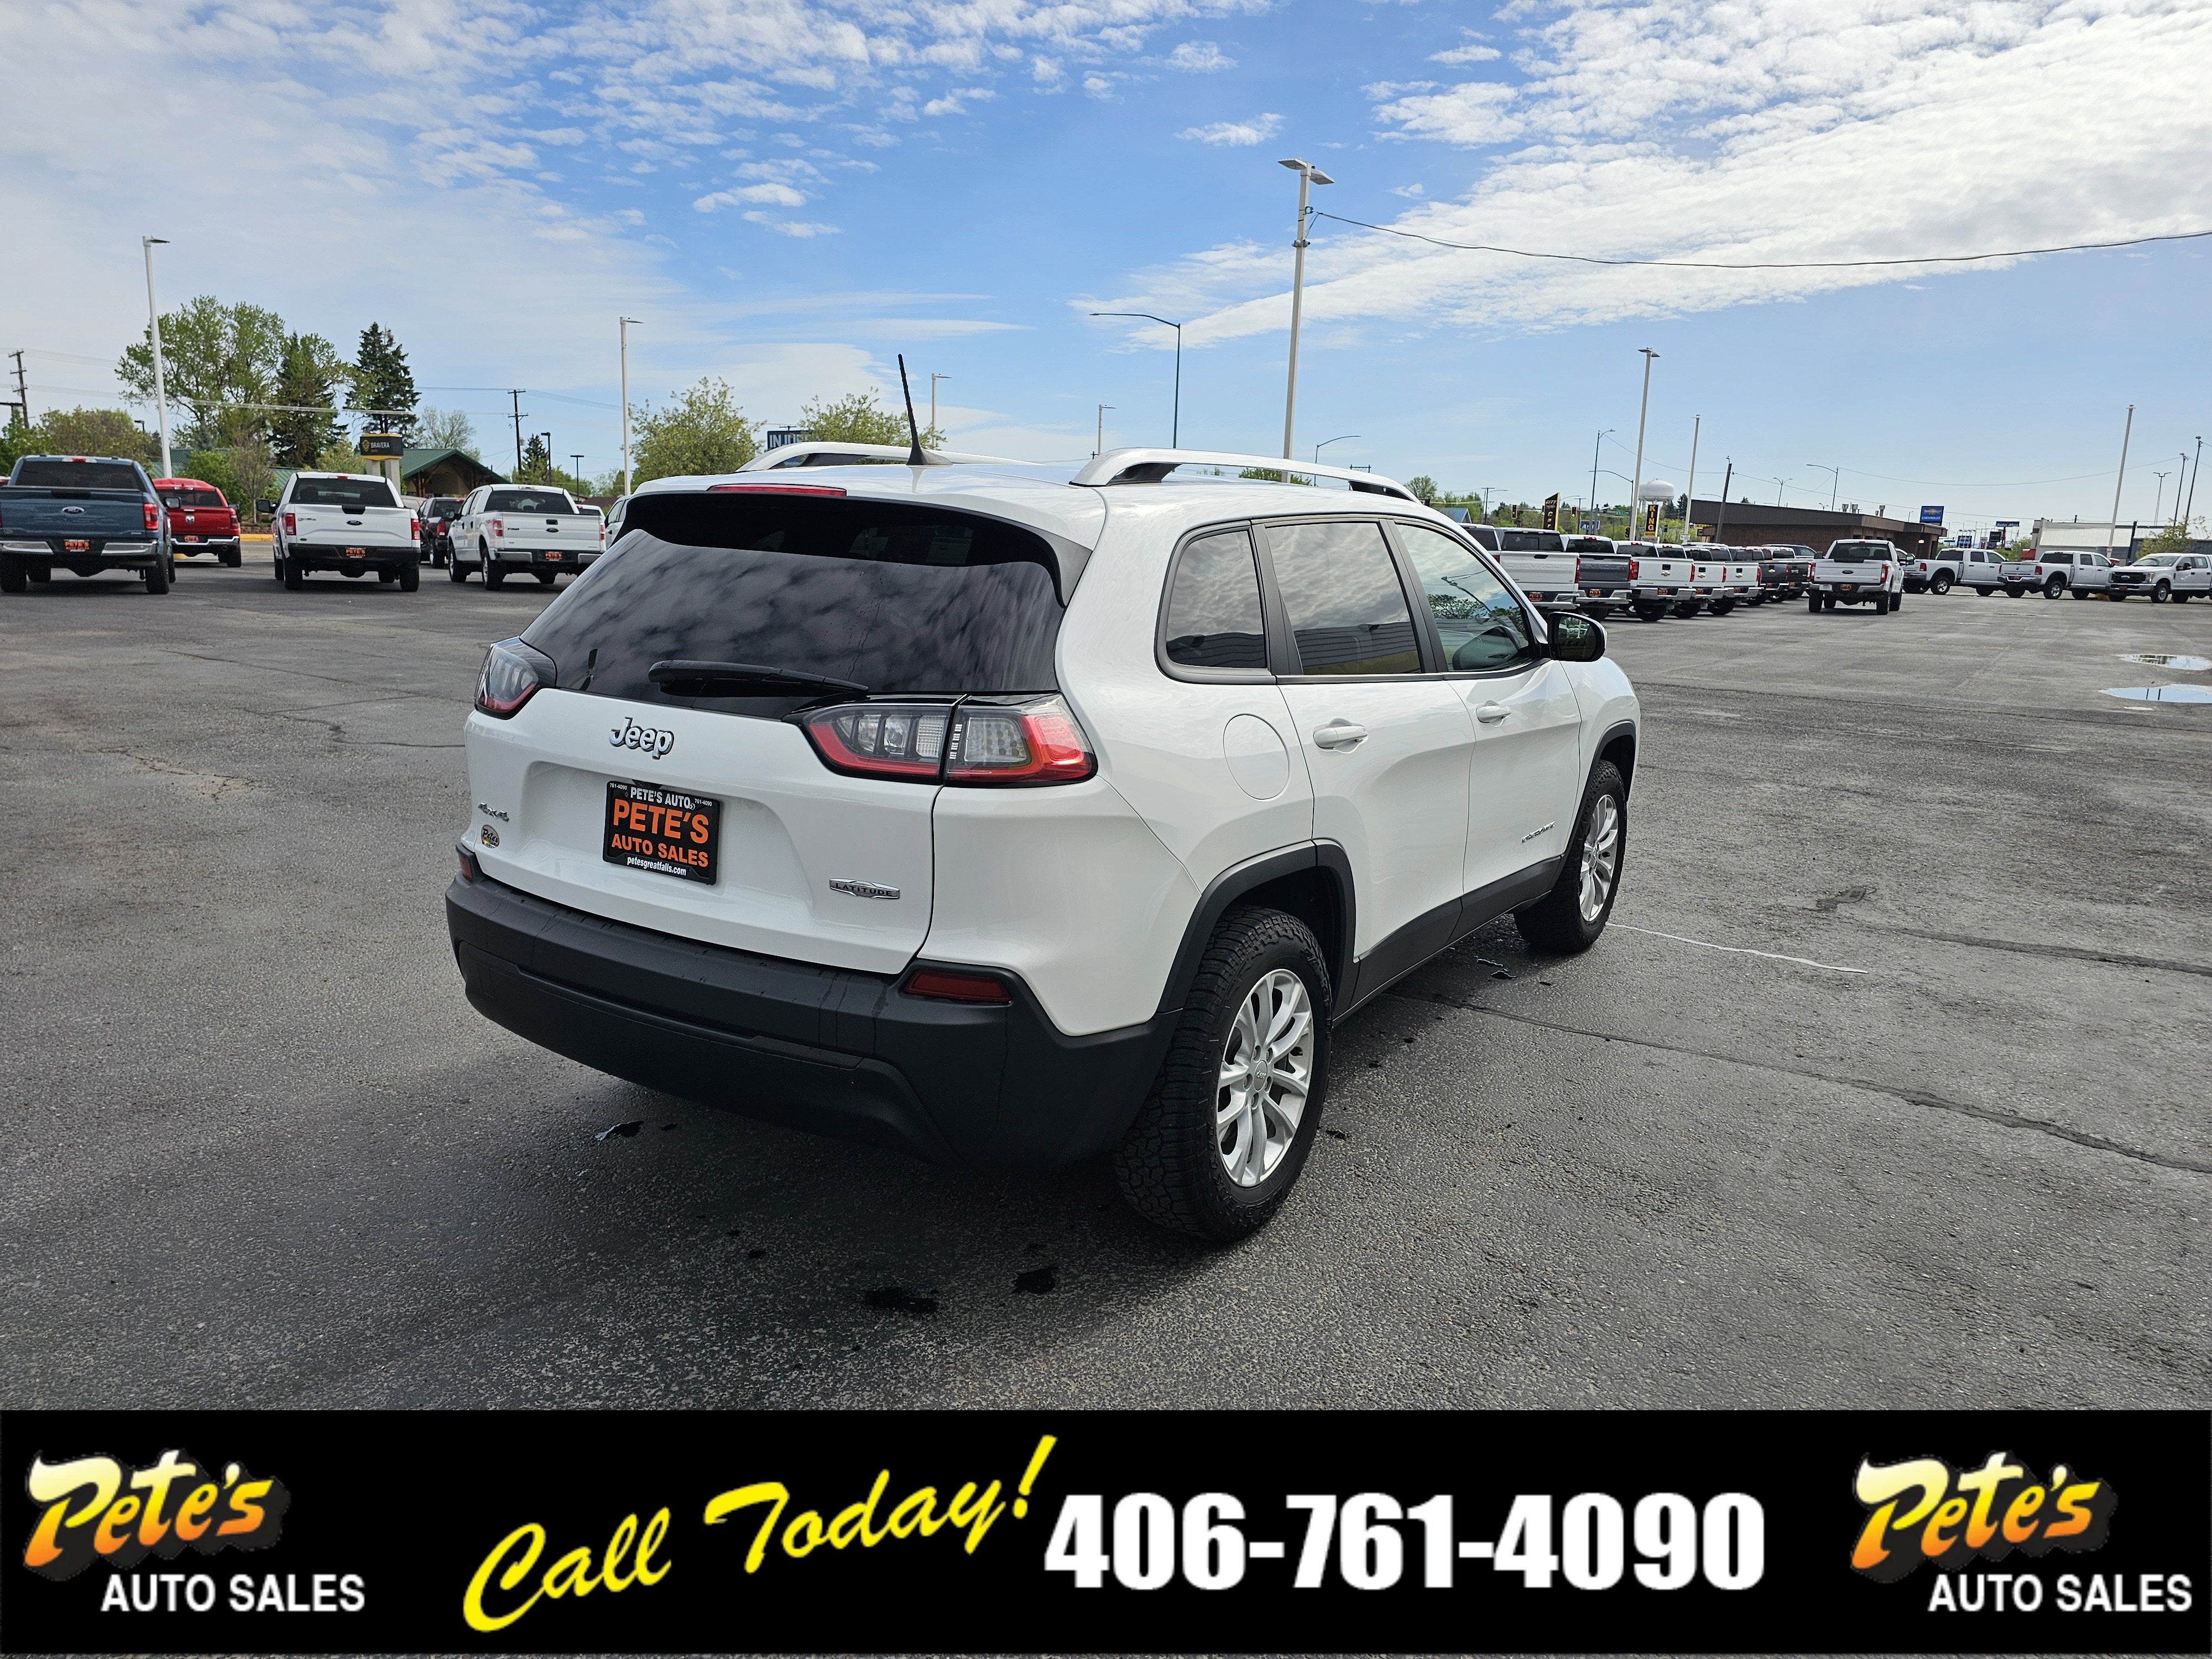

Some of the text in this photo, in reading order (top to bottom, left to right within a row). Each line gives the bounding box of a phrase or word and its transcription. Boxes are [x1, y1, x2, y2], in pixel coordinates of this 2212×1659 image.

[609, 717, 674, 760] Jeep
[609, 782, 713, 809] 761-4090 PETE'S AUTO 761-4090
[613, 799, 709, 844] PETE'S
[611, 833, 708, 868] AUTO SALES
[627, 857, 686, 876] petesgreatfalls.com
[836, 883, 892, 896] LATITUDE
